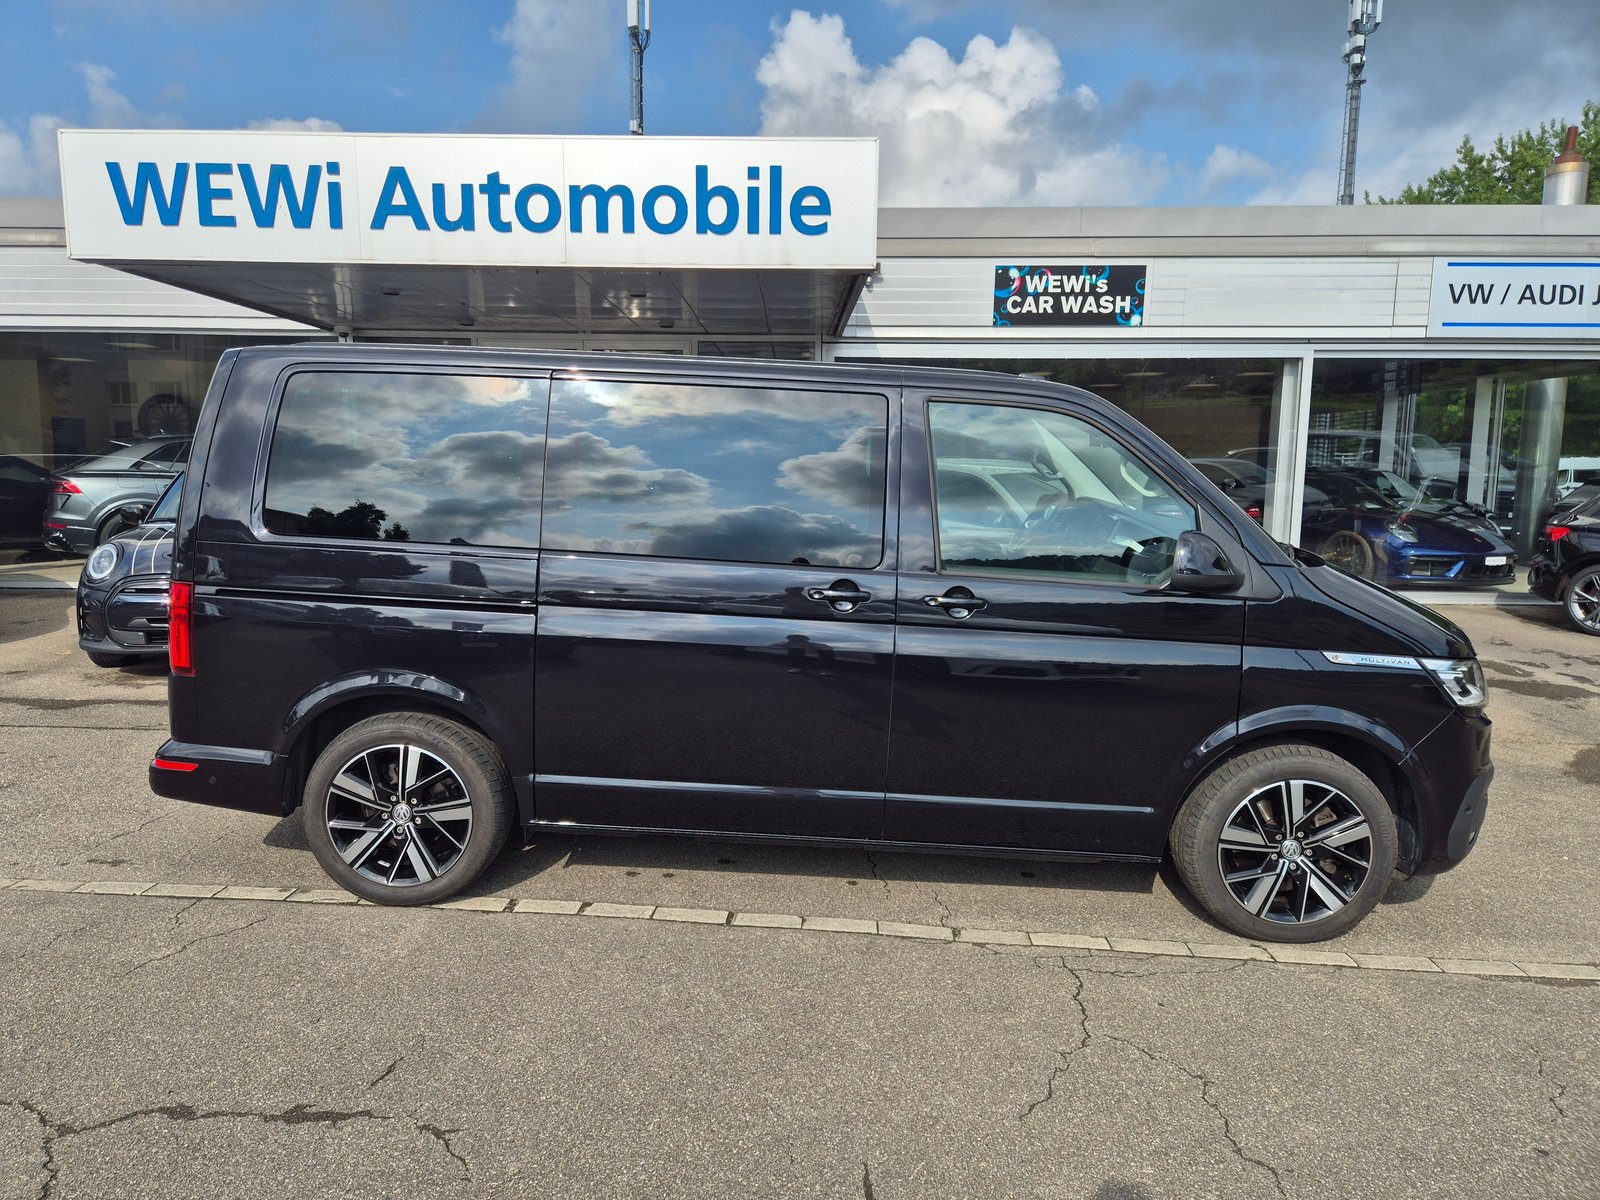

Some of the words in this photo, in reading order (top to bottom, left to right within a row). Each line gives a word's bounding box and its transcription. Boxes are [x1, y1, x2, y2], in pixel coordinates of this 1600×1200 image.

[105, 161, 343, 230] WEWi
[370, 165, 832, 236] Automobile
[1025, 274, 1108, 293] WEWi's
[1448, 283, 1495, 305] VW
[1500, 283, 1512, 305] /
[1517, 284, 1585, 306] AUDI
[1006, 295, 1054, 314] CAR
[1061, 295, 1131, 314] WASH
[1360, 657, 1411, 666] MULTIVAN
